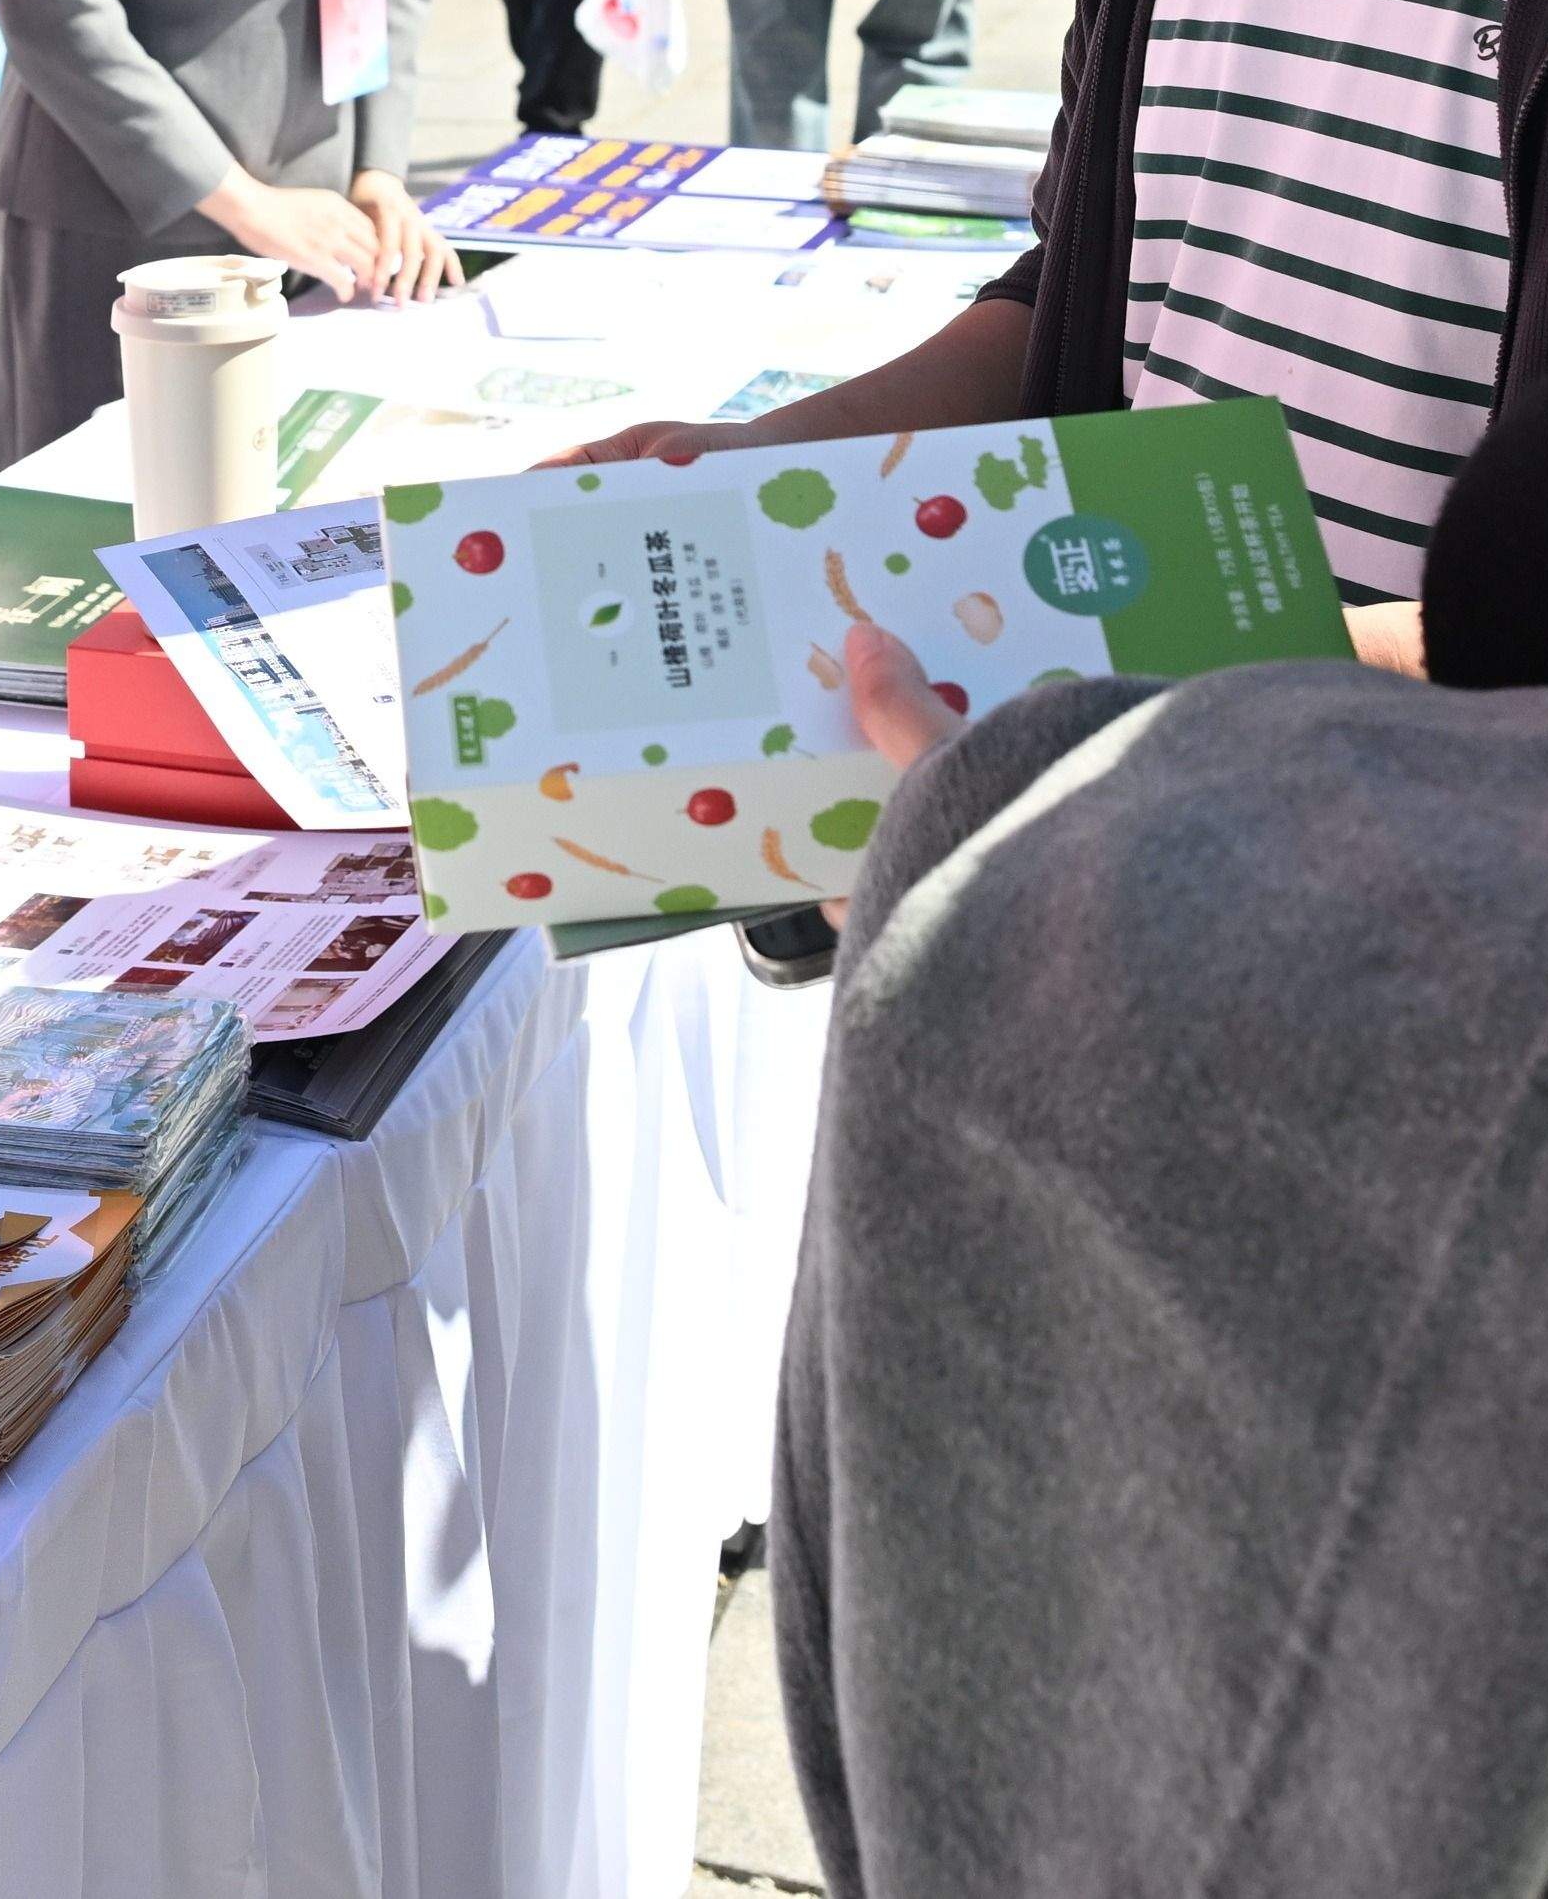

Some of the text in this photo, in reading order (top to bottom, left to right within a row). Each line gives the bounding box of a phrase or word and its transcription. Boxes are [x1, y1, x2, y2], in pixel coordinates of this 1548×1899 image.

[644, 530, 692, 689] 山楂荷叶冬瓜茶
